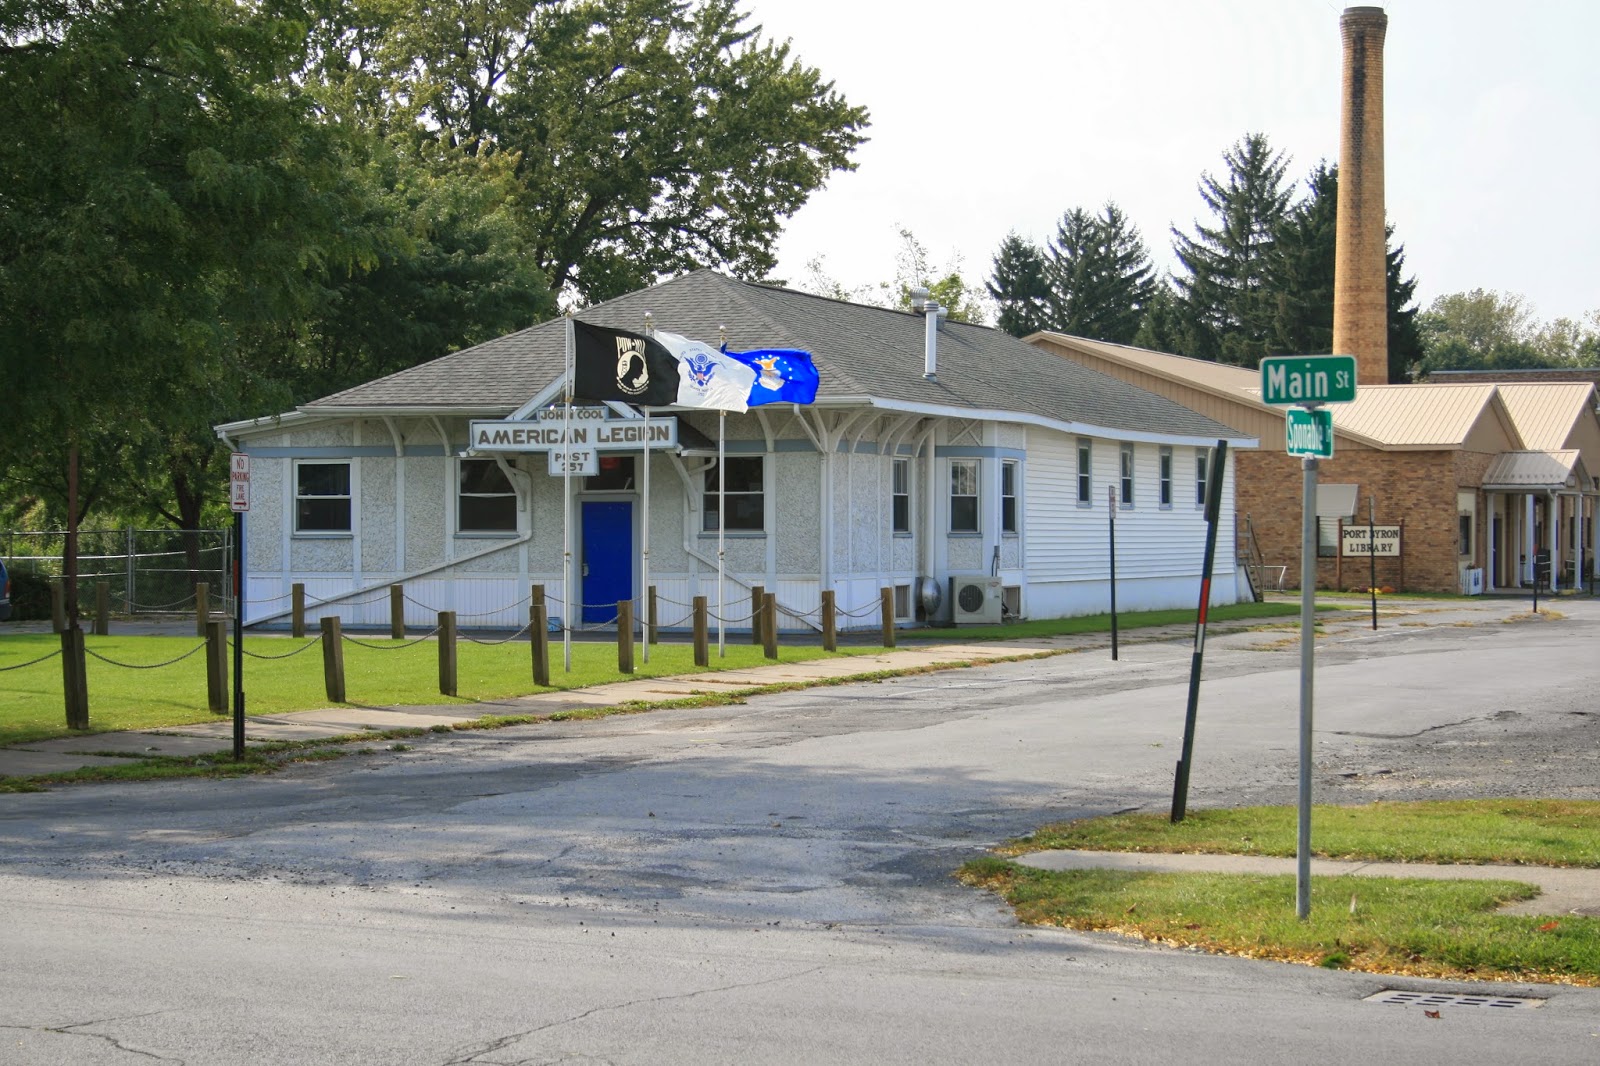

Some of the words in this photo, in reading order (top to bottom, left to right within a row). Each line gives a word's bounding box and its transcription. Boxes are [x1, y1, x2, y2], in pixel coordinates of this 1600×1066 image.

[1268, 362, 1328, 399] Main
[1335, 370, 1350, 388] St
[541, 410, 574, 420] JOHN
[577, 410, 604, 420] COOL
[478, 428, 587, 445] AMERICAN
[597, 425, 670, 443] LEGION
[1288, 414, 1323, 454] Sponable
[554, 452, 590, 462] POST
[236, 458, 245, 470] NO
[561, 462, 584, 472] 257
[232, 471, 249, 481] PARKING
[1343, 529, 1367, 539] PORT
[1349, 543, 1393, 553] LIBRARY
